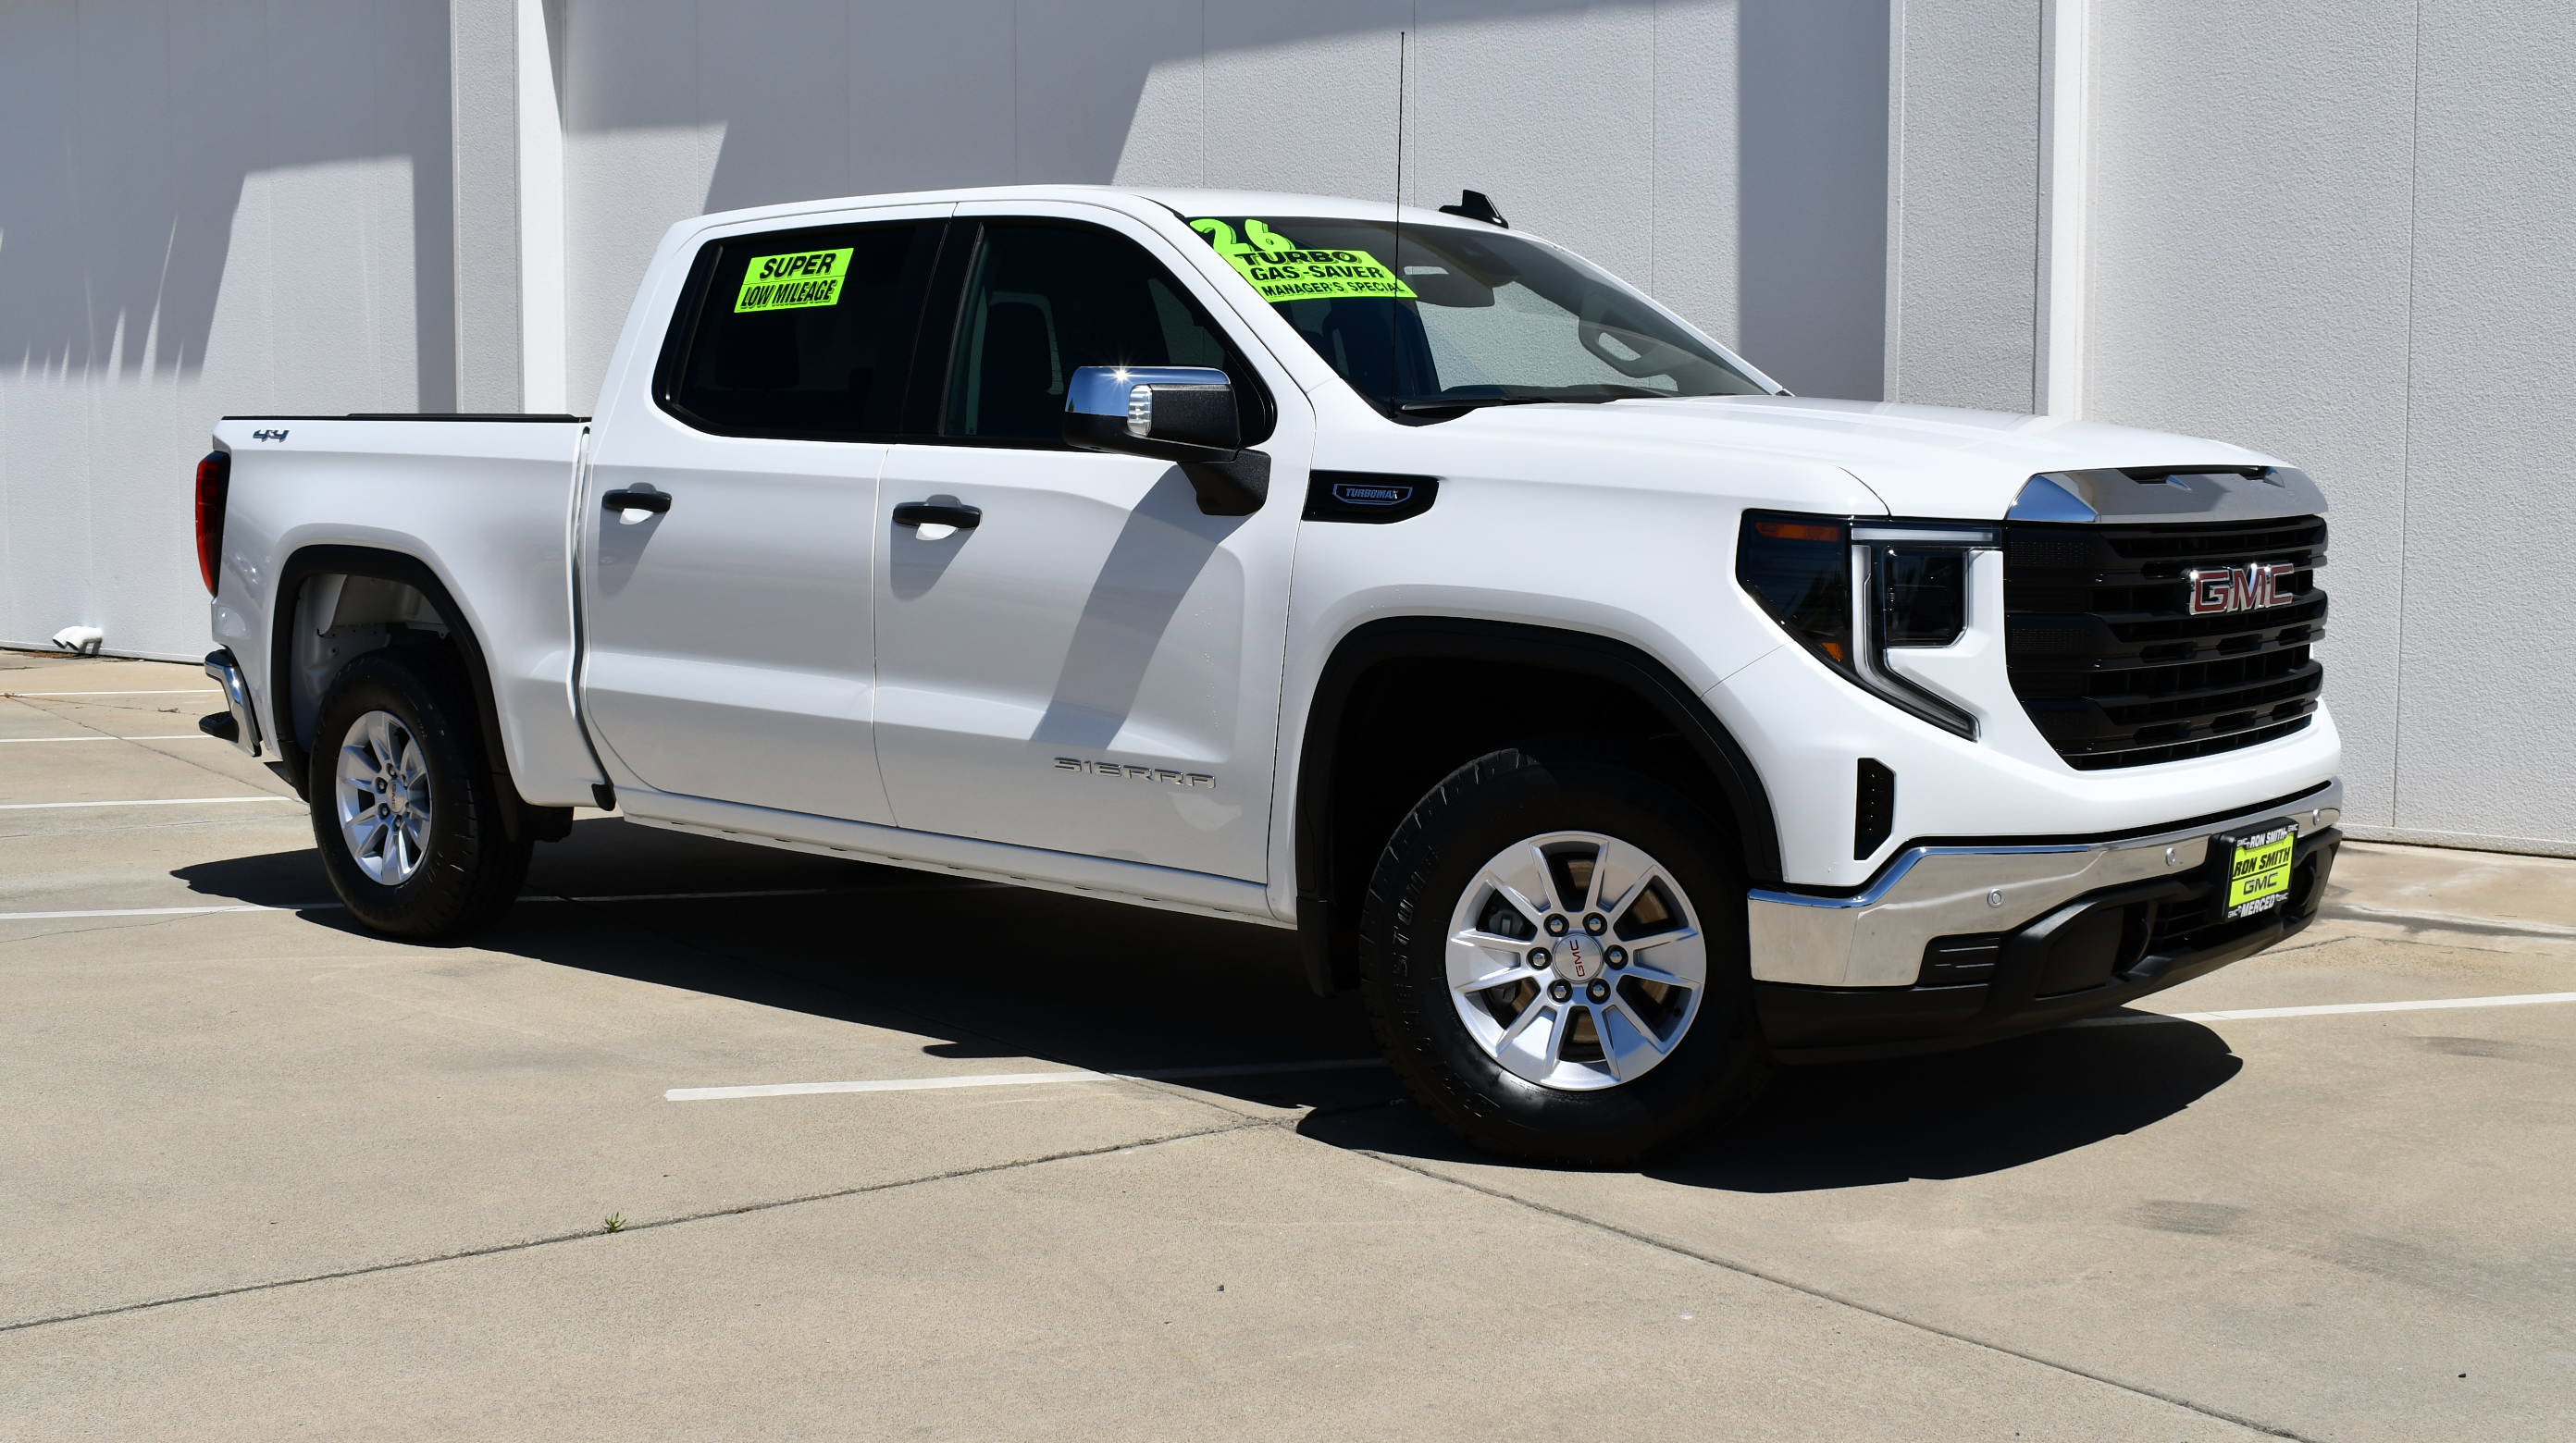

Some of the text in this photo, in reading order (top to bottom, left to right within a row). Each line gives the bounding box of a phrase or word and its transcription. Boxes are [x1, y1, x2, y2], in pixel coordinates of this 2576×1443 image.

[1189, 218, 1296, 253] 26
[759, 253, 836, 280] SUPER
[1234, 251, 1362, 266] TURBO
[740, 279, 837, 309] LOW MILEAGE
[1260, 281, 1408, 298] MANAGER'S SPECIAL
[1345, 487, 1399, 500] TURBOMAX
[2189, 562, 2295, 615] GMC
[1054, 757, 1217, 789] SIERRA
[2249, 832, 2265, 848] RON
[2266, 827, 2286, 845] SMITH
[2233, 846, 2291, 878] RON SMITH
[2243, 872, 2279, 895] GMC
[2240, 894, 2275, 919] MERCED
[1569, 939, 1586, 978] GMC
